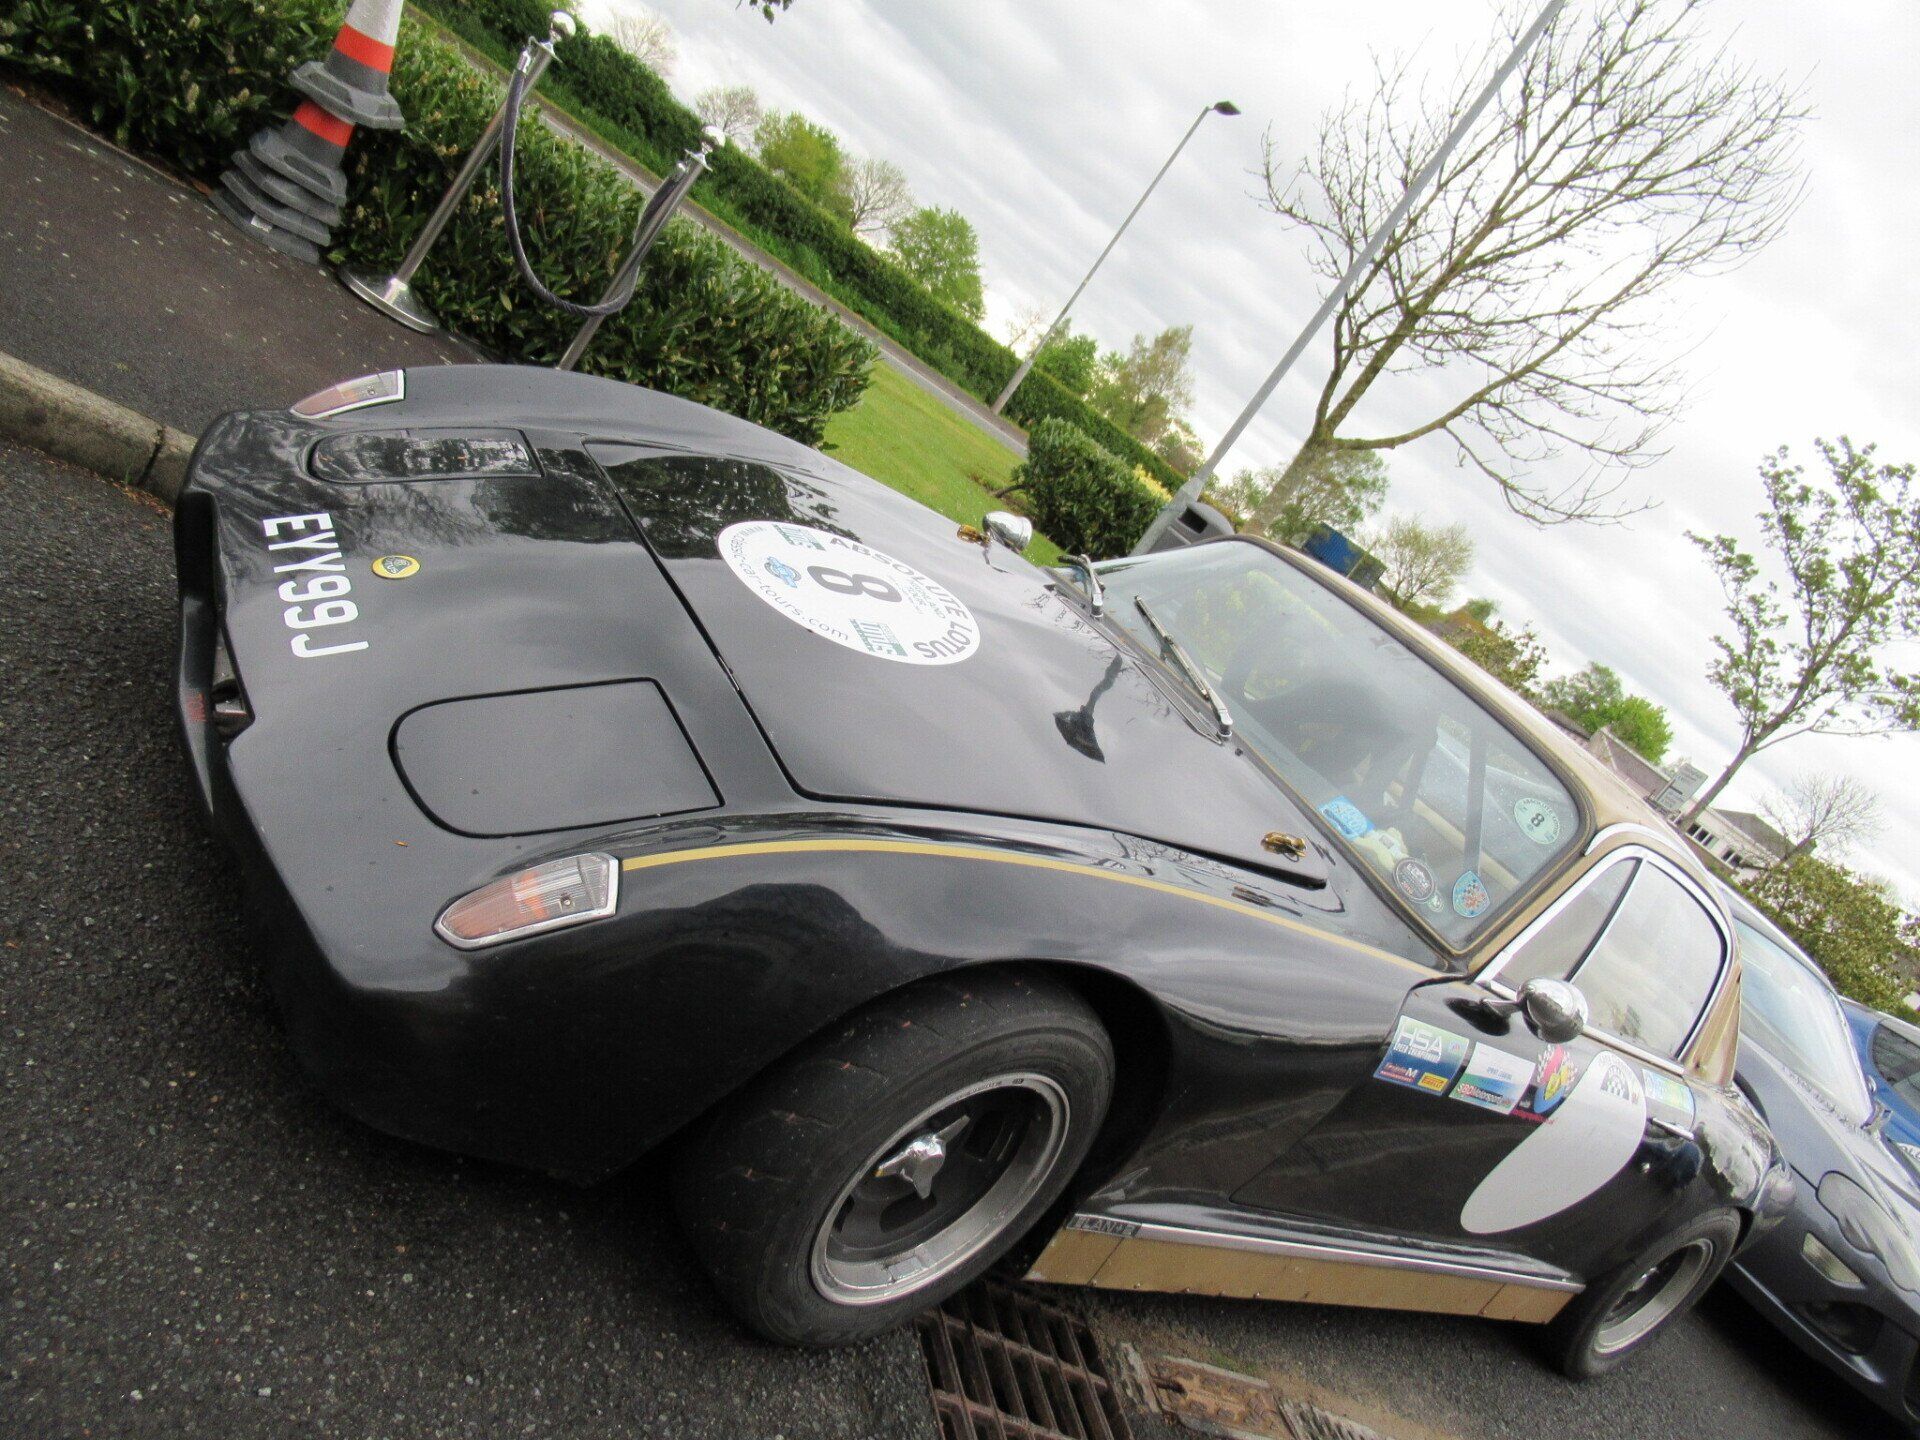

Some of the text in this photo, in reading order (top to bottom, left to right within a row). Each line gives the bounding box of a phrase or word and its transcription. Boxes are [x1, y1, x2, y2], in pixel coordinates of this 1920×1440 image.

[806, 565, 902, 602] 8
[829, 537, 968, 620] ABSOLUTE
[913, 621, 972, 659] LOTUS
[1531, 813, 1545, 827] 8
